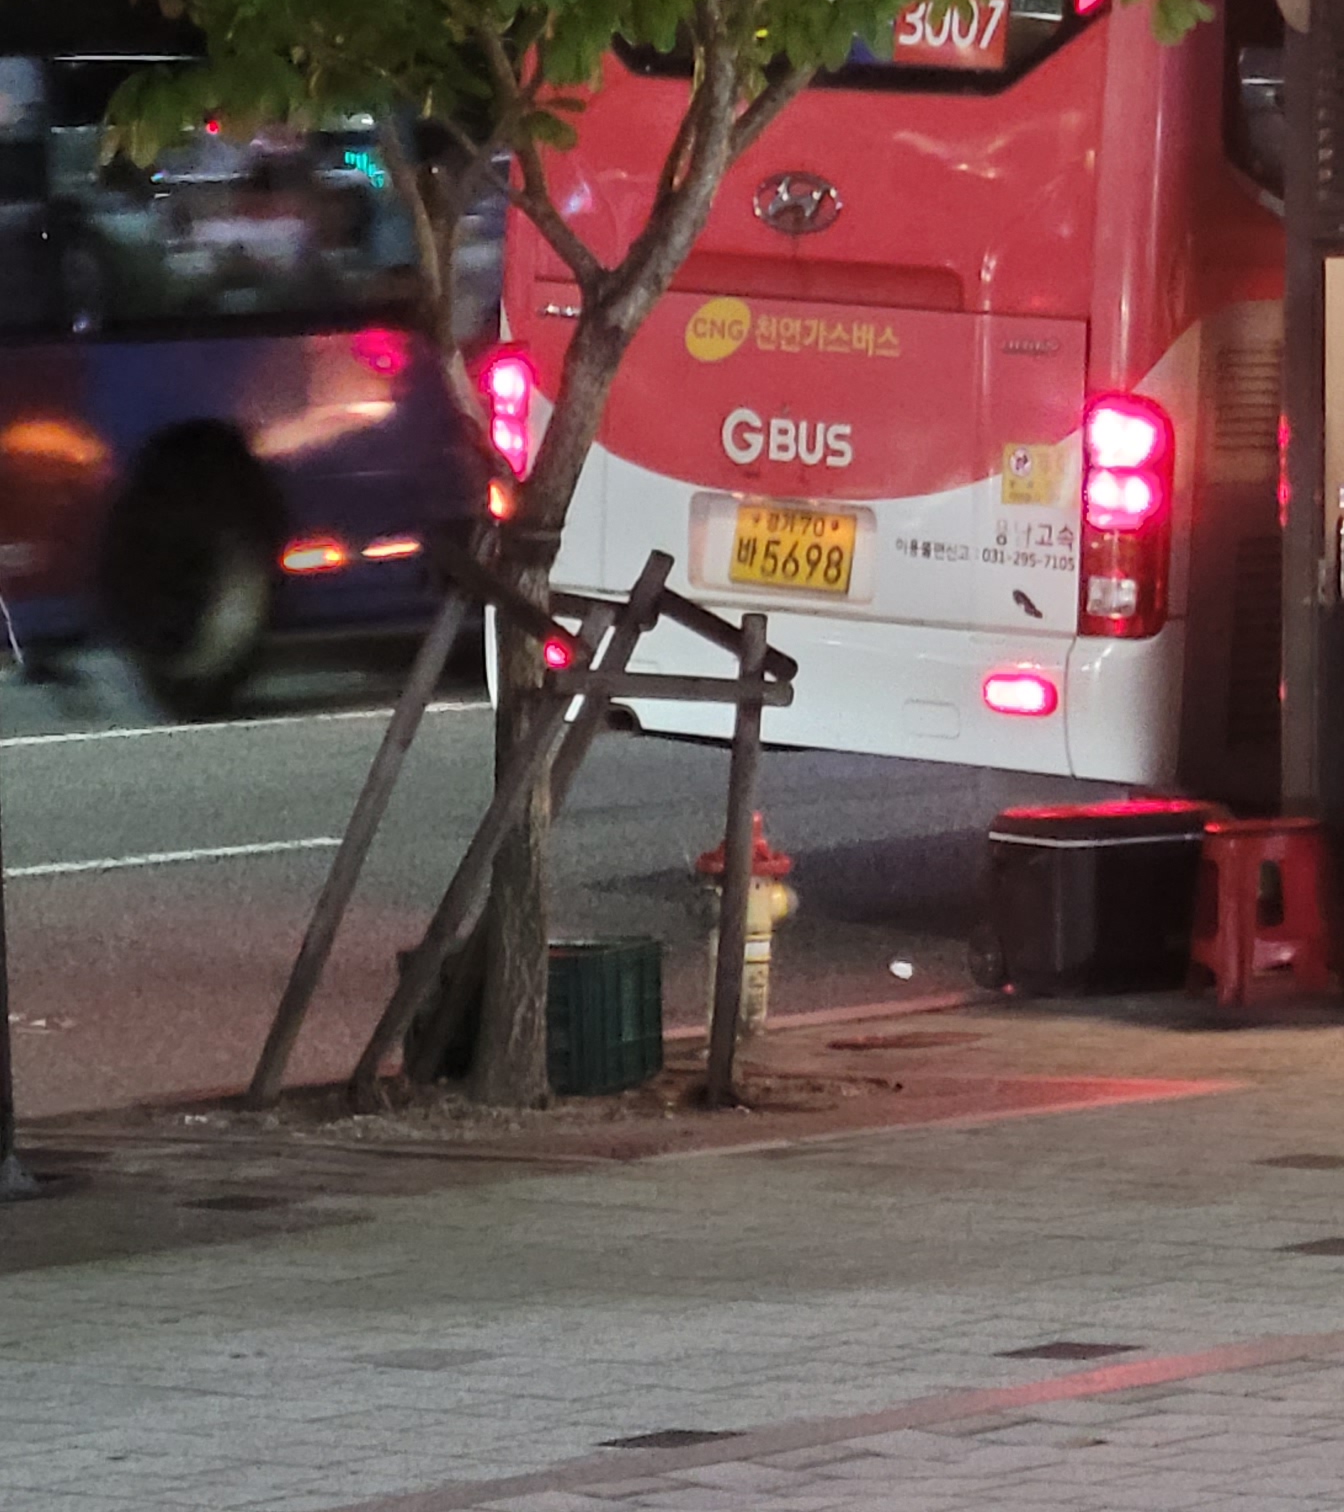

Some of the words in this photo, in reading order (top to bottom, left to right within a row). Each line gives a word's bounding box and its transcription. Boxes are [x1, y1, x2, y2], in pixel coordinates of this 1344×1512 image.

[899, 0, 1006, 50] 3007
[693, 317, 745, 341] CNG
[755, 314, 900, 358] 천연가스버스
